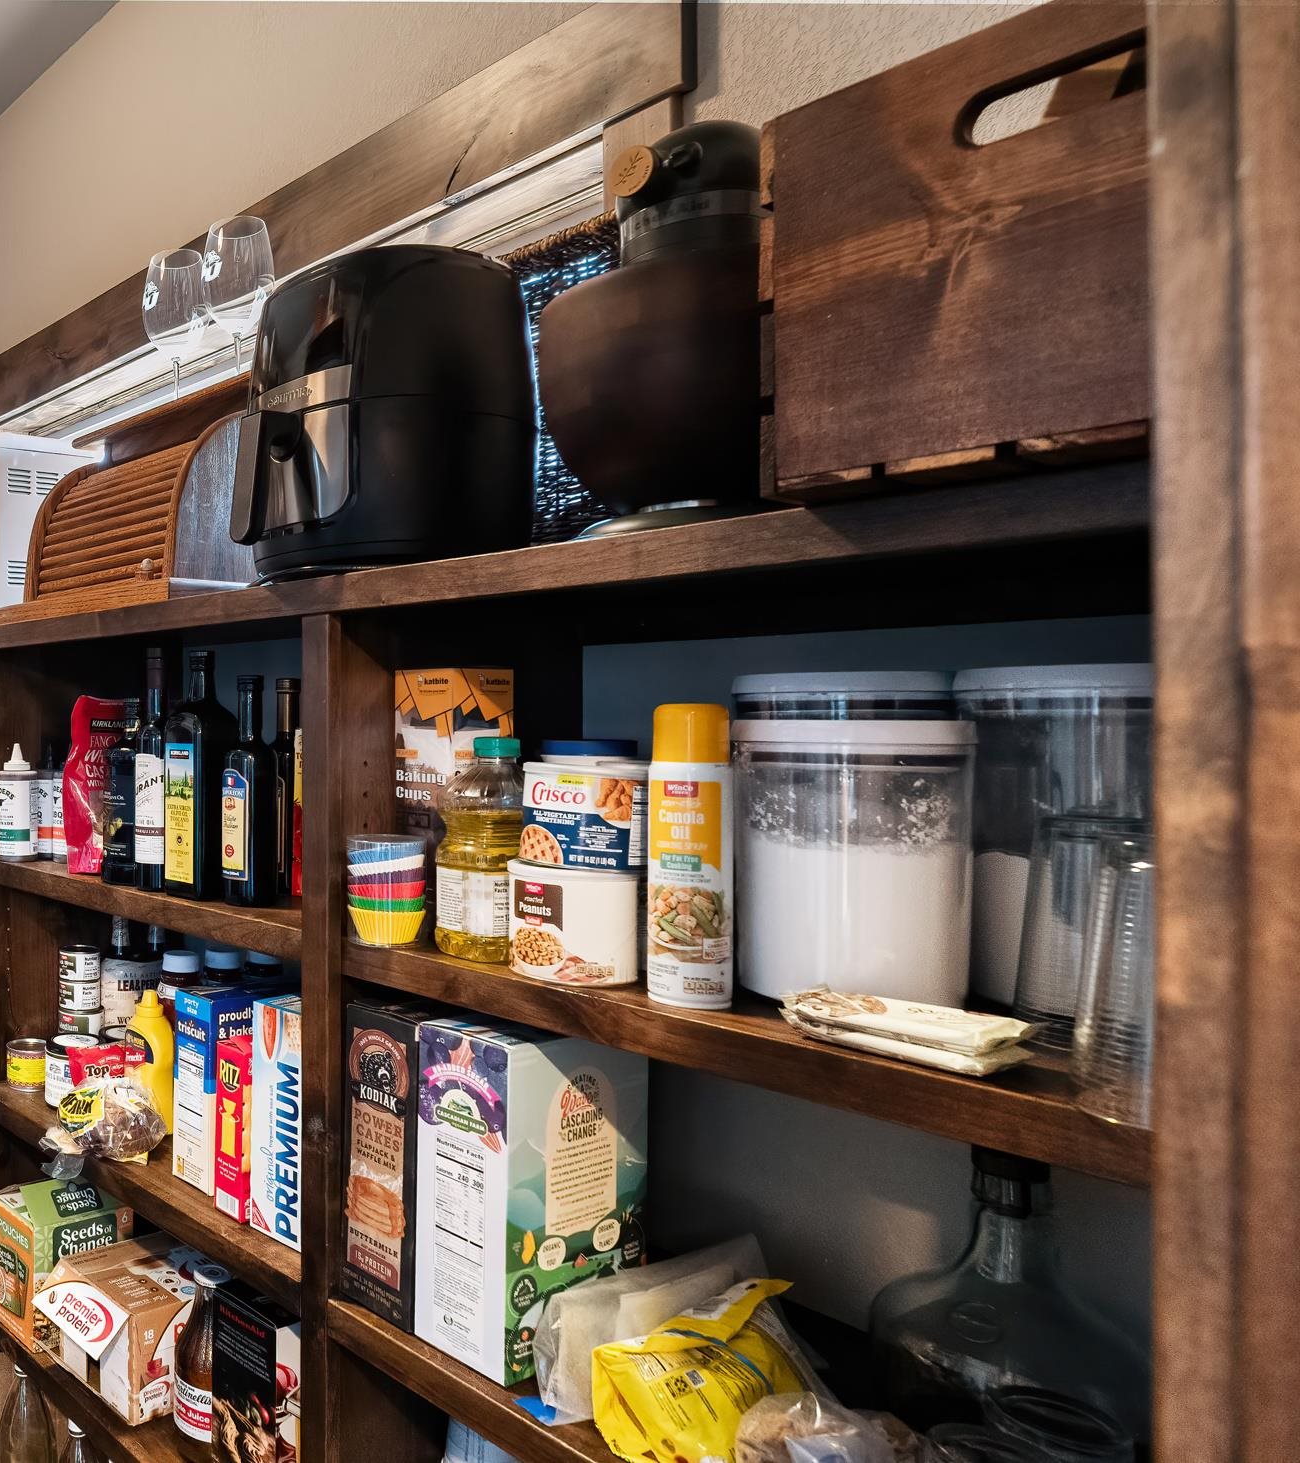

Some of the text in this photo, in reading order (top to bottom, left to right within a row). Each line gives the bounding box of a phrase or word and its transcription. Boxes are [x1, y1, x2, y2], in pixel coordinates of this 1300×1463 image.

[395, 769, 447, 786] Baking
[395, 786, 431, 801] Cups
[658, 809, 705, 825] Canola
[670, 825, 691, 840] Oil
[519, 901, 552, 917] Peanuts
[183, 997, 199, 1009] party
[187, 1005, 198, 1016] size
[218, 1007, 254, 1026] proudl
[177, 1020, 206, 1042] triscuit
[218, 1025, 253, 1039] & bake
[85, 1064, 110, 1078] Top
[220, 1059, 241, 1087] RITZ
[360, 1084, 398, 1113] KODIAK
[354, 1107, 402, 1139] POWER
[437, 1109, 485, 1132] CASCADIAN FARM
[561, 1107, 603, 1130] CASCADING
[356, 1123, 400, 1152] CAKES
[567, 1123, 597, 1143] CHANGE
[275, 1061, 300, 1244] PREMIUM
[356, 1147, 396, 1172] WAFFLE MIX
[357, 1139, 396, 1162] FLAPJACK &
[436, 1137, 485, 1161] Nutrition Facts
[56, 1187, 96, 1204] Change
[66, 1197, 98, 1212] Seeds
[121, 1211, 128, 1223] 6
[60, 1222, 104, 1247] Seeds
[349, 1226, 398, 1259] BUTTERMILK
[58, 1235, 113, 1258] Change
[365, 1256, 392, 1278] PROTEIN
[63, 1292, 103, 1327] premier
[56, 1305, 91, 1337] protein
[220, 1304, 266, 1338] KitchenAid
[143, 1329, 155, 1340] 18
[143, 1385, 165, 1397] premier
[145, 1392, 163, 1404] protein
[187, 1409, 210, 1424] Juice
